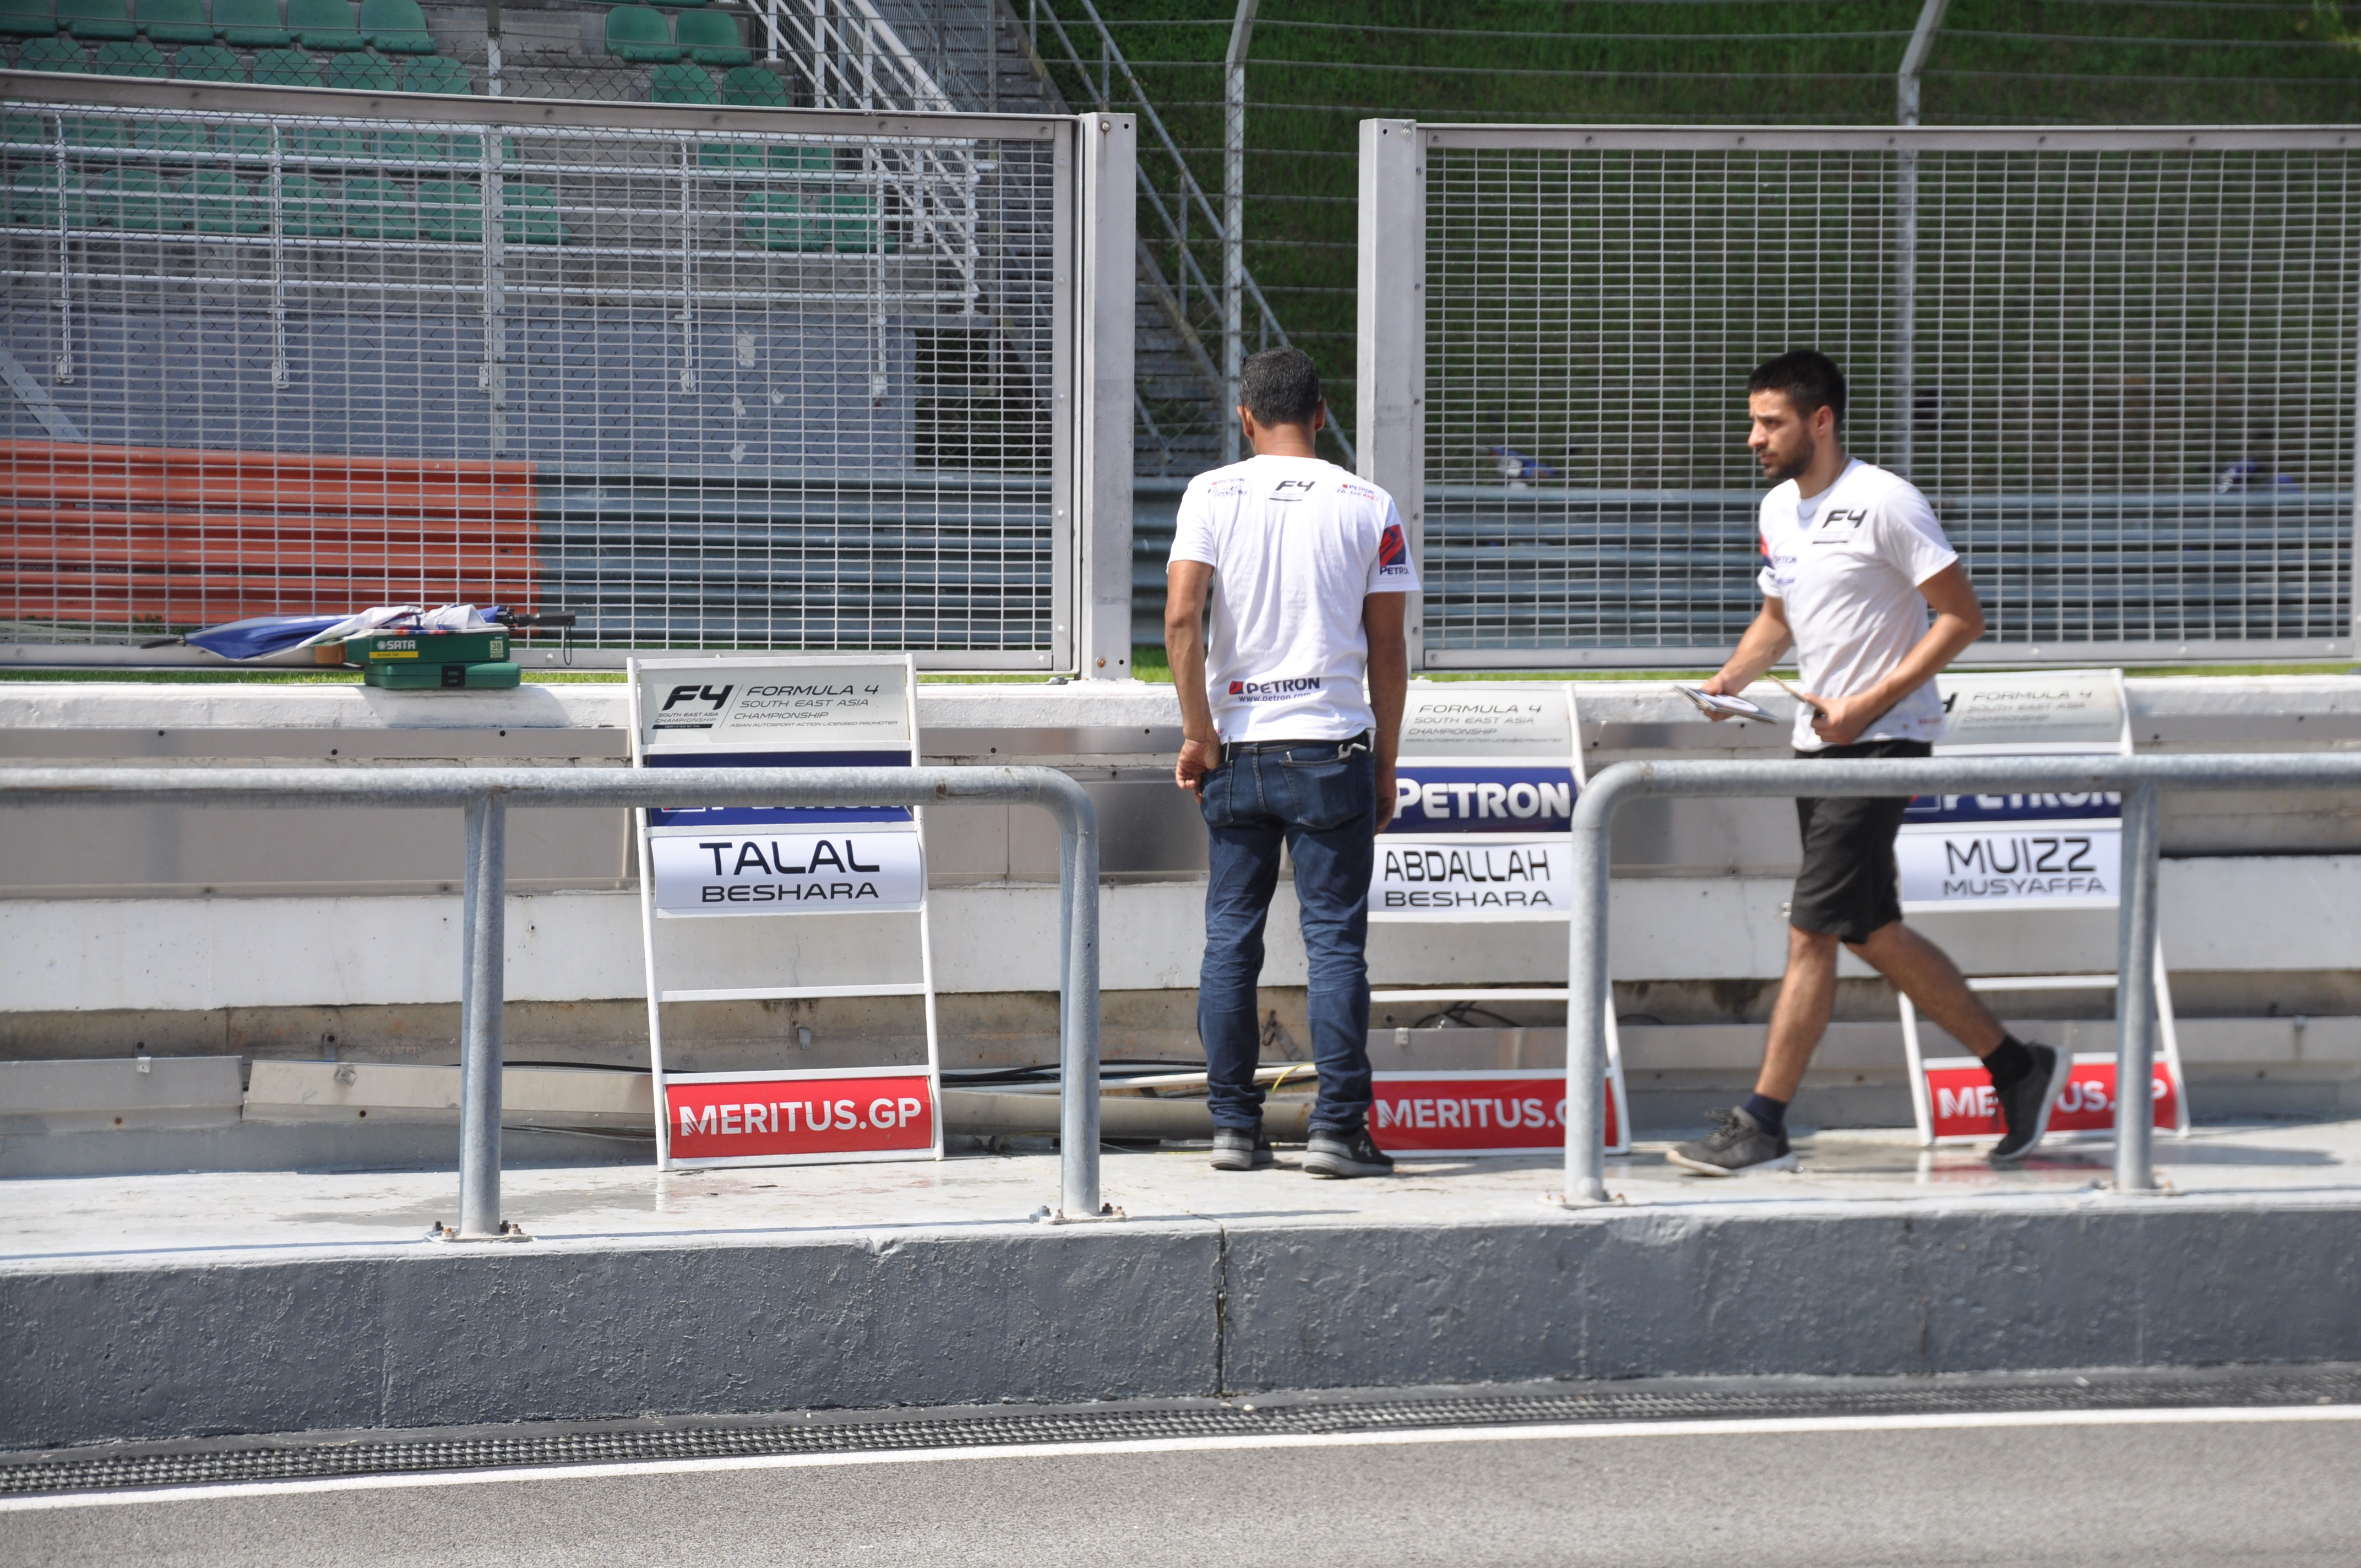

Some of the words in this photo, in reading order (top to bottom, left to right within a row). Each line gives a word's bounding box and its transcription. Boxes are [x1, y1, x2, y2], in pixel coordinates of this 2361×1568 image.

[1275, 481, 1316, 492] F4
[1821, 509, 1868, 529] F4
[1379, 566, 1410, 575] PETRO
[387, 640, 416, 650] SATA
[746, 685, 854, 696] FORMULA
[864, 684, 879, 695] 4
[1246, 677, 1320, 694] PETRON
[661, 684, 735, 711] F4
[739, 700, 789, 708] SOUTH
[795, 699, 834, 707] EAST
[1239, 692, 1311, 702] www.petron.com
[1973, 690, 2070, 701] FORMULA
[1419, 705, 1519, 713] FORMULA
[1528, 705, 1542, 713] 4
[1394, 778, 1571, 819] PETRON
[699, 839, 880, 875] TALAL
[1944, 836, 2097, 875] MUIZZ
[1385, 850, 1551, 882] ABDALLAH
[701, 882, 879, 902] BESHARA
[1943, 876, 2107, 897] MUSYAFFA
[1385, 890, 1553, 907] BESHARA
[679, 1097, 922, 1137] MERITUS.GP
[1377, 1098, 1566, 1129] MERITUS.
